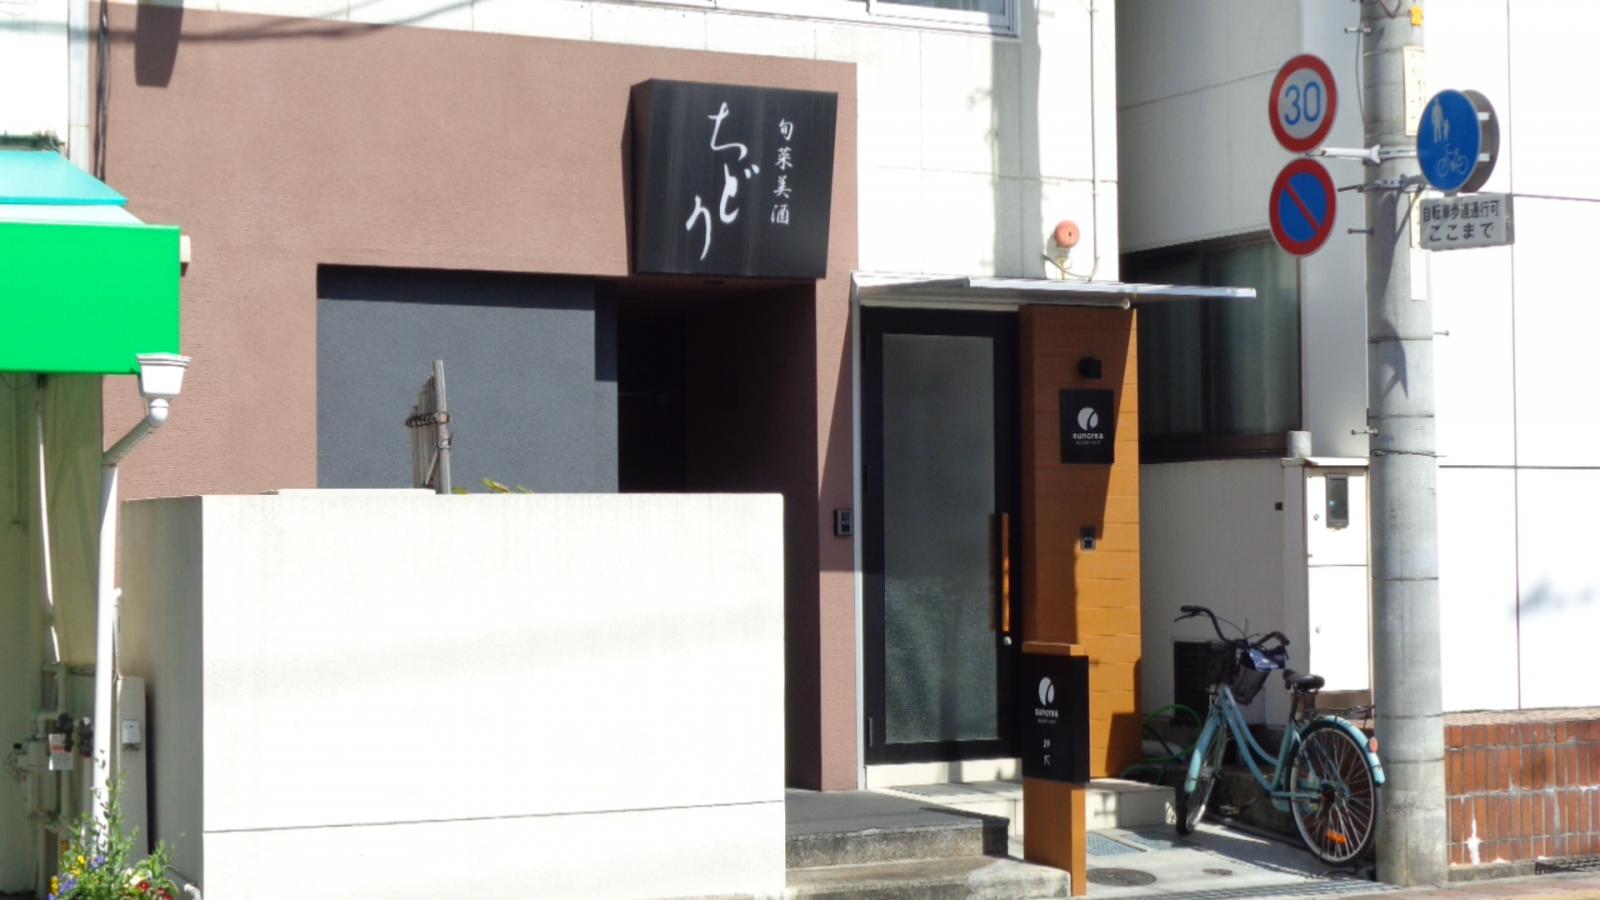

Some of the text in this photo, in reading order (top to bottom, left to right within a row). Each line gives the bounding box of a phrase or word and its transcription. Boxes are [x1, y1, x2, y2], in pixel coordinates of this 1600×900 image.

[1284, 81, 1321, 126] 30
[685, 101, 760, 261] ちどり
[770, 117, 794, 226] 旬菜美酒
[1423, 199, 1500, 223] 自転車歩道通行可
[1429, 222, 1495, 242] ここまで
[1072, 432, 1104, 440] suncrea
